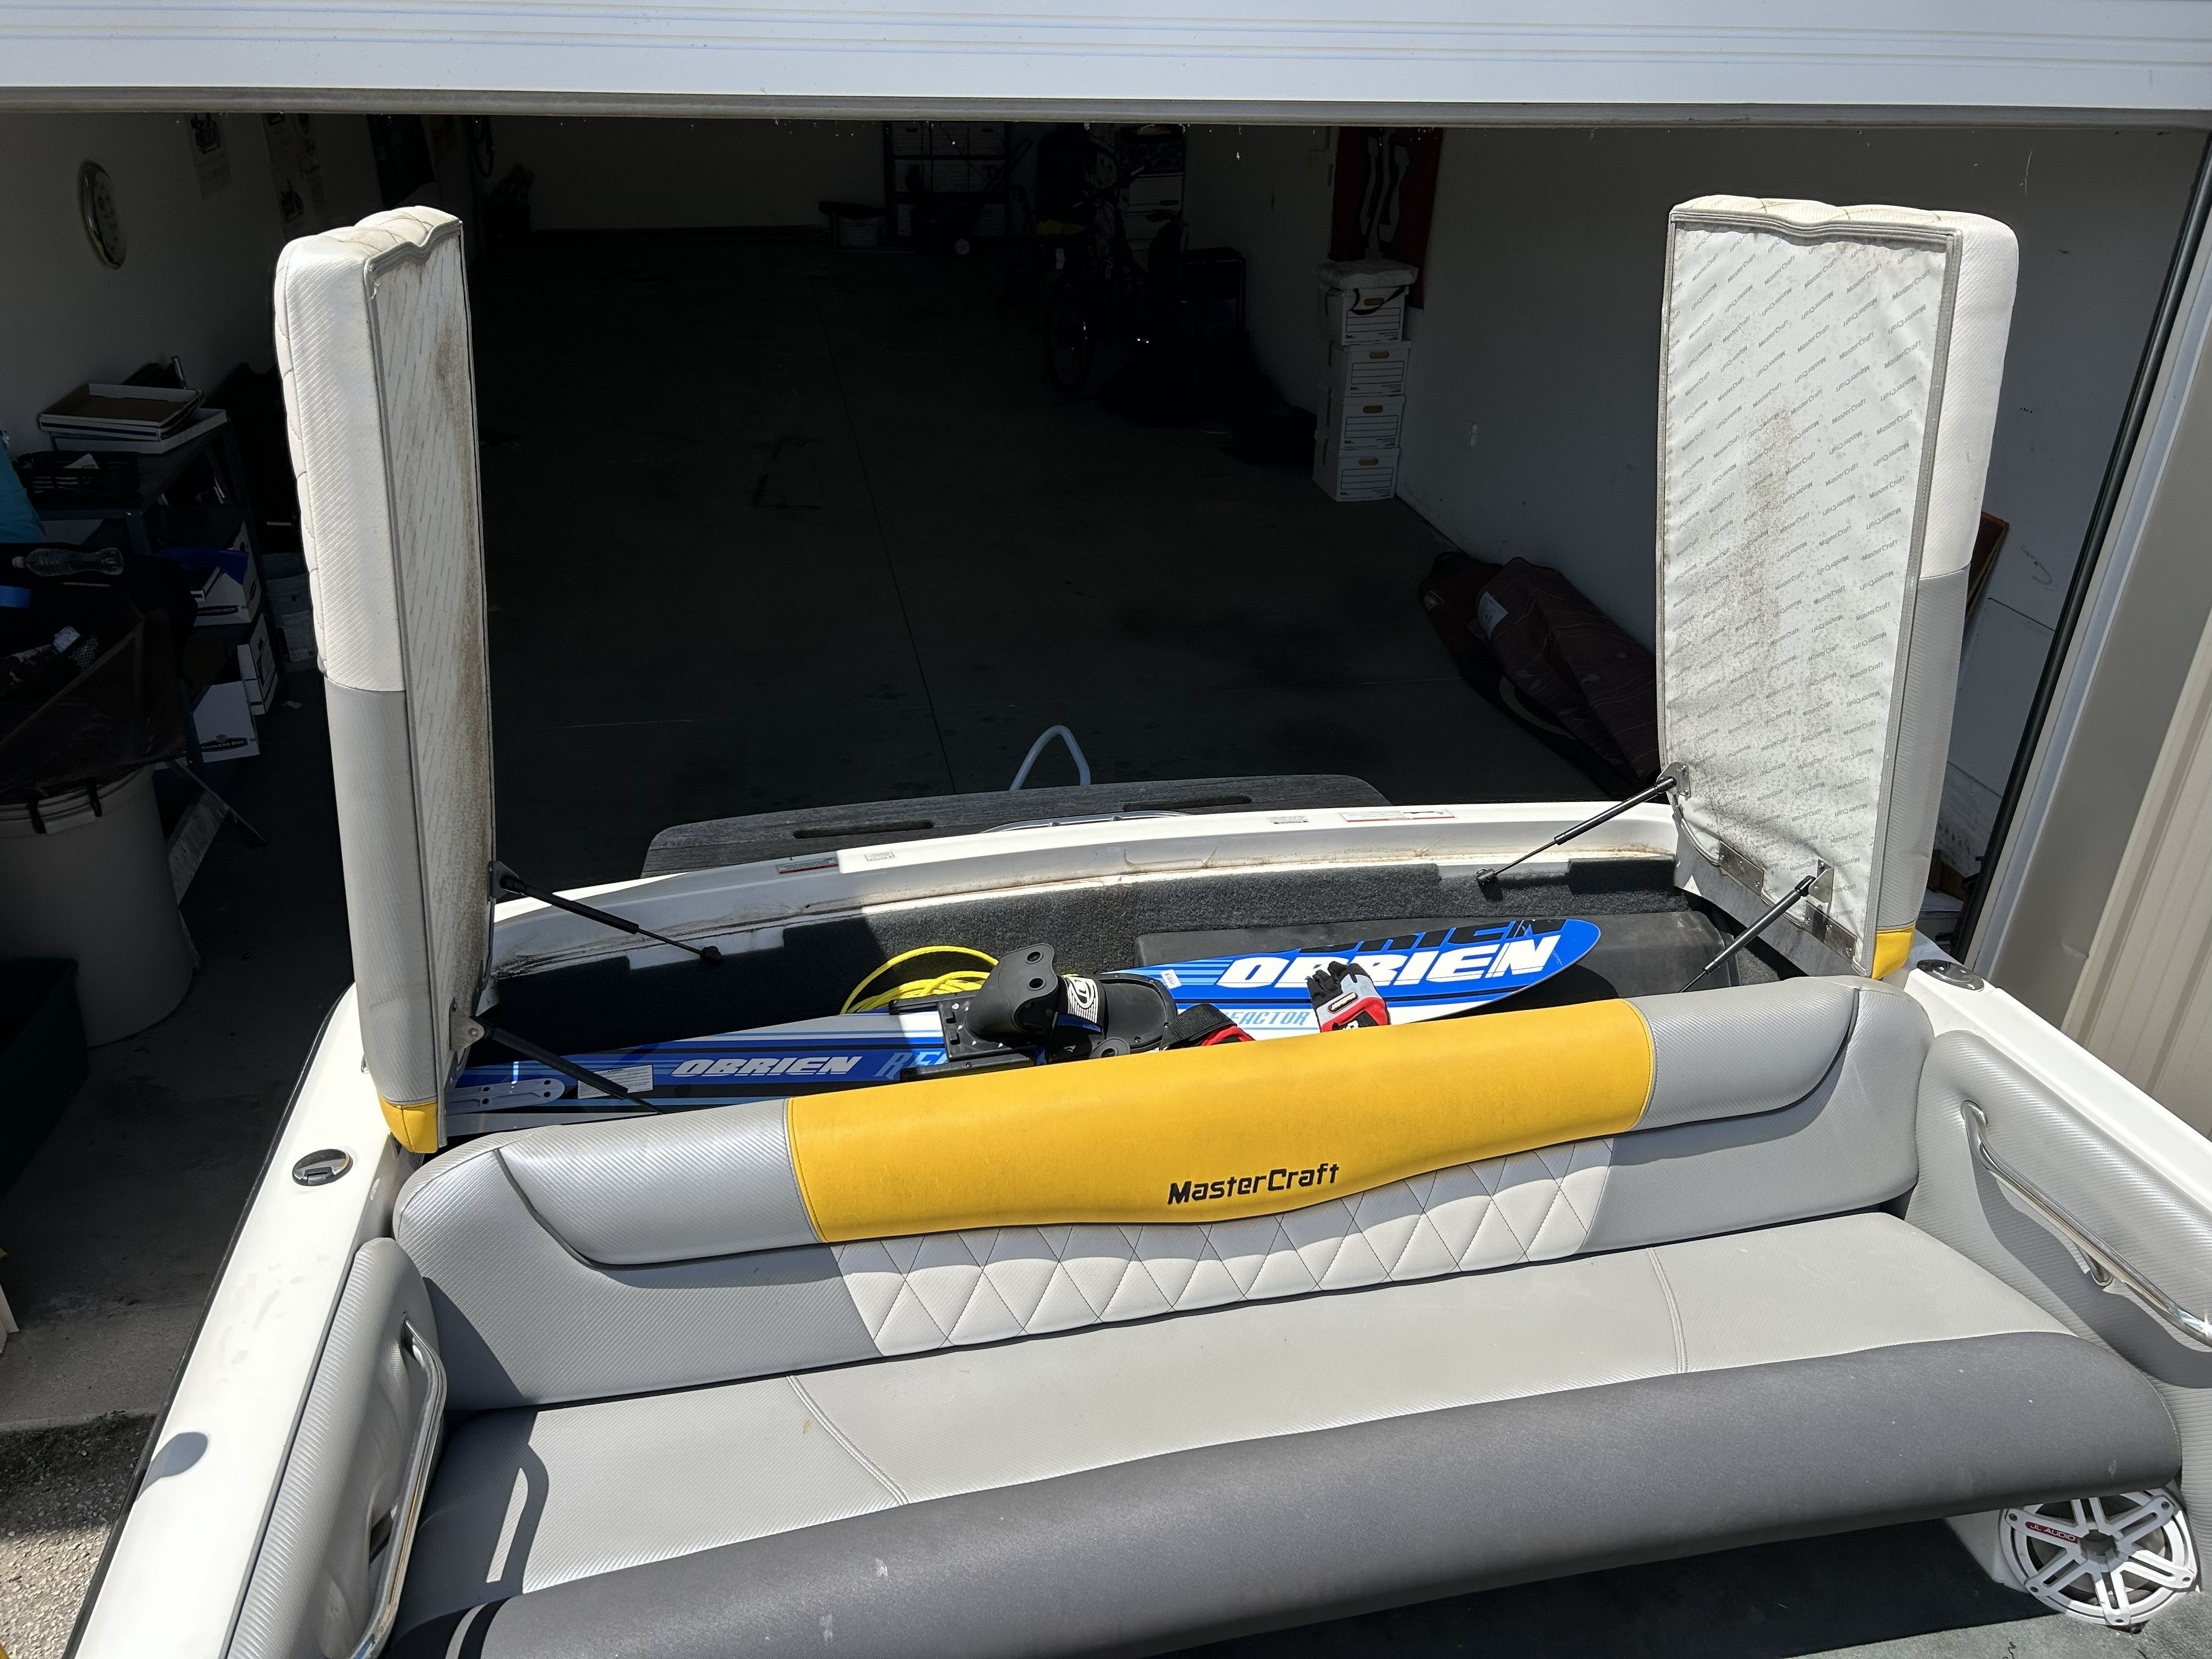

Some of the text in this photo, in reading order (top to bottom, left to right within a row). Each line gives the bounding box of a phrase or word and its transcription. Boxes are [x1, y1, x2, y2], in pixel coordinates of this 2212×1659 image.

[1692, 253, 1718, 281] MasterCraft
[1728, 253, 1755, 283] MasterCraft
[1764, 255, 1794, 285] MasterCraft
[1804, 257, 1836, 289] MasterCraft
[1847, 261, 1882, 295] MasterCraft
[1691, 283, 1717, 311] MasterCraft
[1892, 268, 1931, 302] MasterCraft
[1725, 284, 1752, 313] MasterCraft
[1762, 287, 1791, 317] MasterCraft
[1801, 290, 1833, 320] MasterCraft
[1843, 296, 1878, 327] MasterCraft
[1888, 303, 1926, 336] MasterCraft
[1689, 313, 1713, 340] MasterCraft
[1723, 315, 1750, 343] MasterCraft
[1759, 319, 1788, 347] MasterCraft
[1797, 324, 1829, 353] MasterCraft
[1687, 342, 1712, 368] MasterCraft
[1839, 330, 1874, 360] MasterCraft
[1883, 339, 1921, 370] MasterCraft
[1720, 346, 1747, 372] MasterCraft
[1756, 350, 1785, 377] MasterCraft
[1795, 356, 1826, 383] MasterCraft
[1685, 371, 1709, 396] MasterCraft
[1718, 376, 1744, 402] MasterCraft
[1836, 364, 1870, 392] MasterCraft
[1880, 373, 1917, 403] MasterCraft
[1753, 382, 1781, 408] MasterCraft
[1791, 388, 1821, 415] MasterCraft
[1684, 400, 1708, 424] MasterCraft
[1716, 405, 1742, 430] MasterCraft
[1832, 397, 1865, 425] MasterCraft
[1876, 408, 1912, 436] MasterCraft
[1751, 411, 1779, 437] MasterCraft
[1788, 420, 1819, 445] MasterCraft
[1681, 428, 1705, 452] MasterCraft
[1713, 435, 1739, 458] MasterCraft
[1829, 429, 1862, 455] MasterCraft
[1681, 456, 1705, 477] MasterCraft
[1747, 443, 1775, 466] MasterCraft
[1785, 451, 1815, 476] MasterCraft
[1873, 441, 1909, 467] MasterCraft
[1711, 463, 1737, 485] MasterCraft
[1825, 462, 1858, 487] MasterCraft
[1679, 484, 1702, 505] MasterCraft
[1782, 481, 1812, 505] MasterCraft
[1869, 474, 1904, 500] MasterCraft
[1709, 492, 1734, 513] MasterCraft
[1822, 493, 1855, 516] MasterCraft
[1708, 519, 1734, 540] MasterCraft
[1780, 512, 1809, 534] MasterCraft
[1866, 506, 1901, 531] MasterCraft
[1675, 538, 1699, 557] MasterCraft
[1819, 524, 1851, 547] MasterCraft
[1778, 541, 1807, 562] MasterCraft
[1862, 539, 1897, 562] MasterCraft
[1817, 554, 1848, 575] MasterCraft
[1775, 571, 1804, 591] MasterCraft
[1859, 569, 1894, 591] MasterCraft
[1814, 585, 1844, 605] MasterCraft
[1773, 599, 1802, 618] MasterCraft
[1855, 601, 1889, 622] MasterCraft
[1812, 614, 1842, 633] MasterCraft
[1770, 628, 1798, 646] MasterCraft
[1853, 631, 1887, 650] MasterCraft
[1808, 644, 1838, 662] MasterCraft
[1849, 661, 1882, 680] MasterCraft
[1803, 700, 1832, 716] MasterCraft
[1847, 690, 1880, 707] MasterCraft
[1843, 719, 1876, 736] MasterCraft
[1841, 747, 1873, 763] MasterCraft
[1837, 776, 1869, 790] MasterCraft
[1835, 803, 1866, 816] MasterCraft
[1831, 831, 1862, 843] MasterCraft
[671, 1056, 863, 1077] OBRIEN
[1167, 1163, 1340, 1205] MasterCraft
[2029, 1523, 2076, 1542] JL AUDIO
